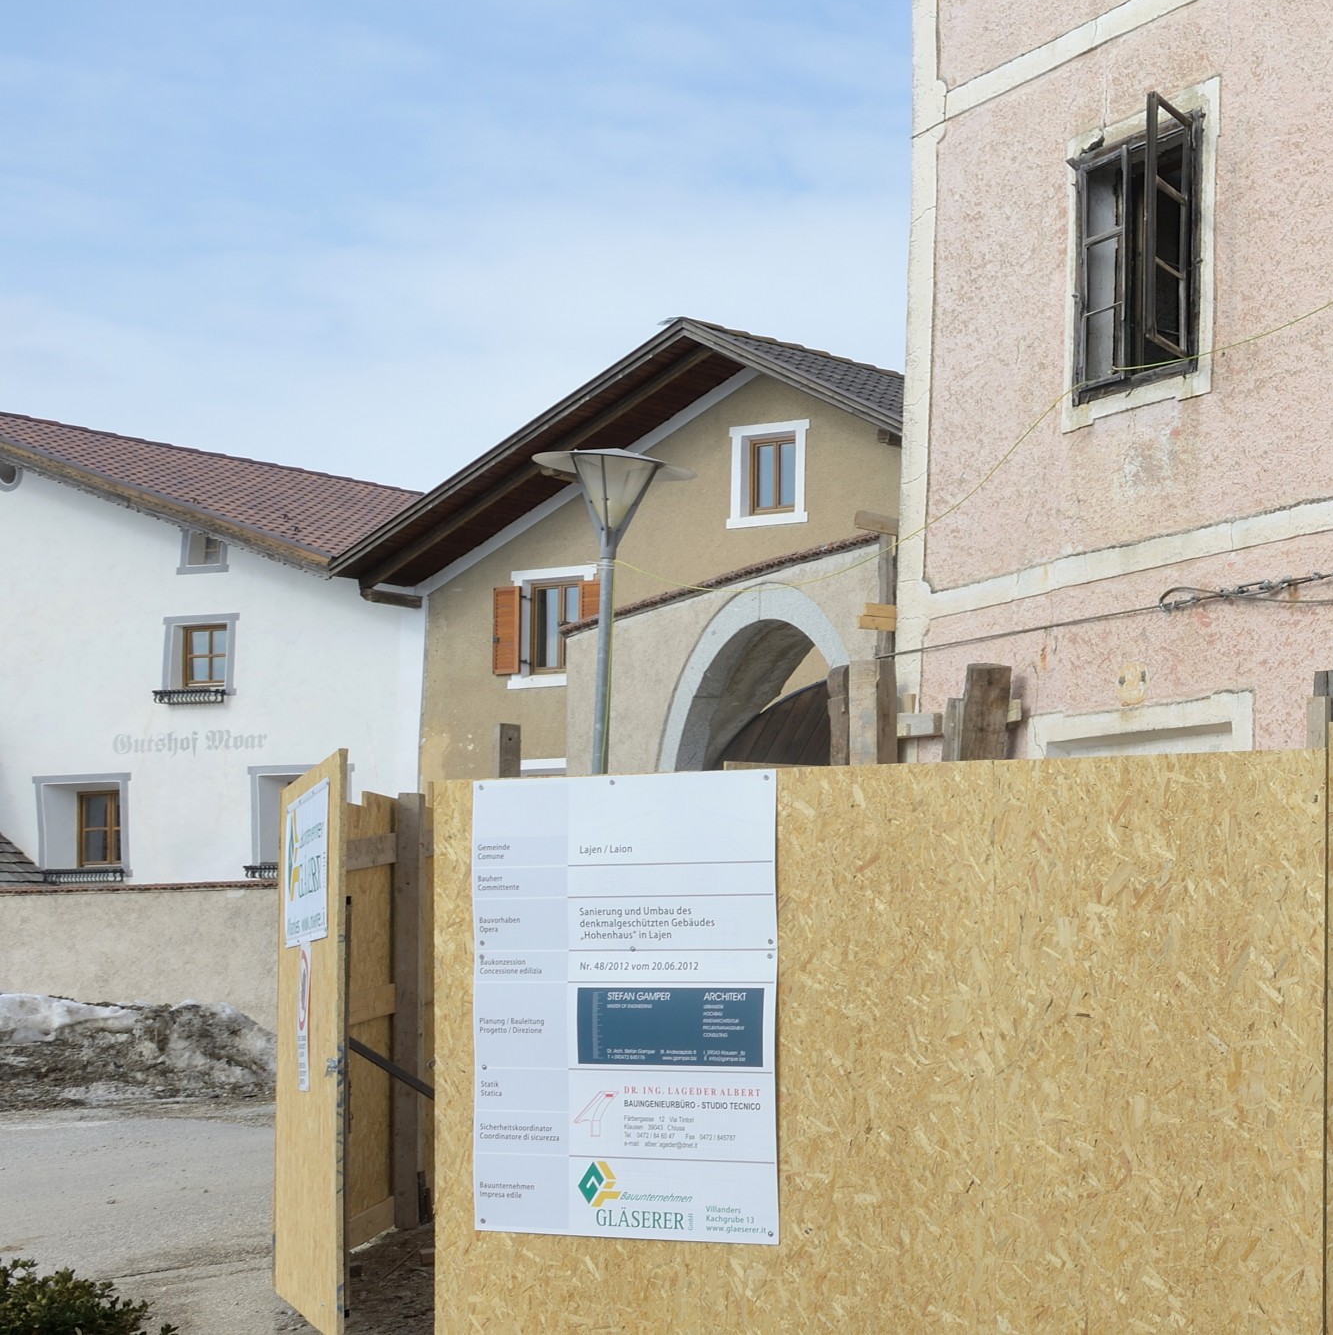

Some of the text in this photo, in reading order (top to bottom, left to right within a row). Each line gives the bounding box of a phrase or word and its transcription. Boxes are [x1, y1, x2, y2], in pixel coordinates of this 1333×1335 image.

[112, 729, 268, 758] Gutshof Moar
[477, 843, 511, 851] Gemeinde
[579, 845, 602, 856] Lajen
[609, 844, 633, 854] Laion
[477, 884, 520, 892] Committente
[579, 906, 692, 918] Sanierung und Umbau des
[579, 918, 715, 930] denkmalgeschützten Gebäudes
[479, 926, 499, 934] Opera
[638, 931, 647, 939] in
[648, 931, 672, 941] Lajen
[480, 958, 526, 966] Baukonzession
[579, 962, 593, 971] Nr.
[594, 961, 630, 971] 48/2012
[651, 961, 699, 971] 20.06.2012
[479, 967, 542, 975] Concessione edilizia
[607, 992, 671, 1001] STEFAN GAMPER
[703, 992, 747, 1001] ARCHITEKT
[479, 1017, 506, 1027] Planung
[510, 1017, 545, 1027] Bauleitung
[479, 1026, 508, 1035] Progetto
[512, 1026, 543, 1034] Direzione
[480, 1080, 500, 1088] Statik
[480, 1089, 503, 1097] Statica
[623, 1086, 761, 1097] DR. ING. LAGEDER ALBERT
[623, 1099, 696, 1109] BAUINGENIEURBÜRO
[701, 1101, 728, 1110] STUDIO
[729, 1102, 761, 1111] TECNICO
[480, 1123, 553, 1132] Sicherheitskoordinator
[480, 1132, 522, 1141] Coordinatore
[523, 1133, 530, 1141] di
[480, 1181, 535, 1191] Bauunternehmen
[480, 1190, 522, 1199] Impresa edile
[620, 1191, 693, 1203] Bauunternehmen
[705, 1205, 742, 1214] Villanders
[596, 1207, 685, 1230] GLÄSERER
[705, 1215, 755, 1224] Kachgrube 13
[705, 1225, 767, 1234] www.glaeserer.it
